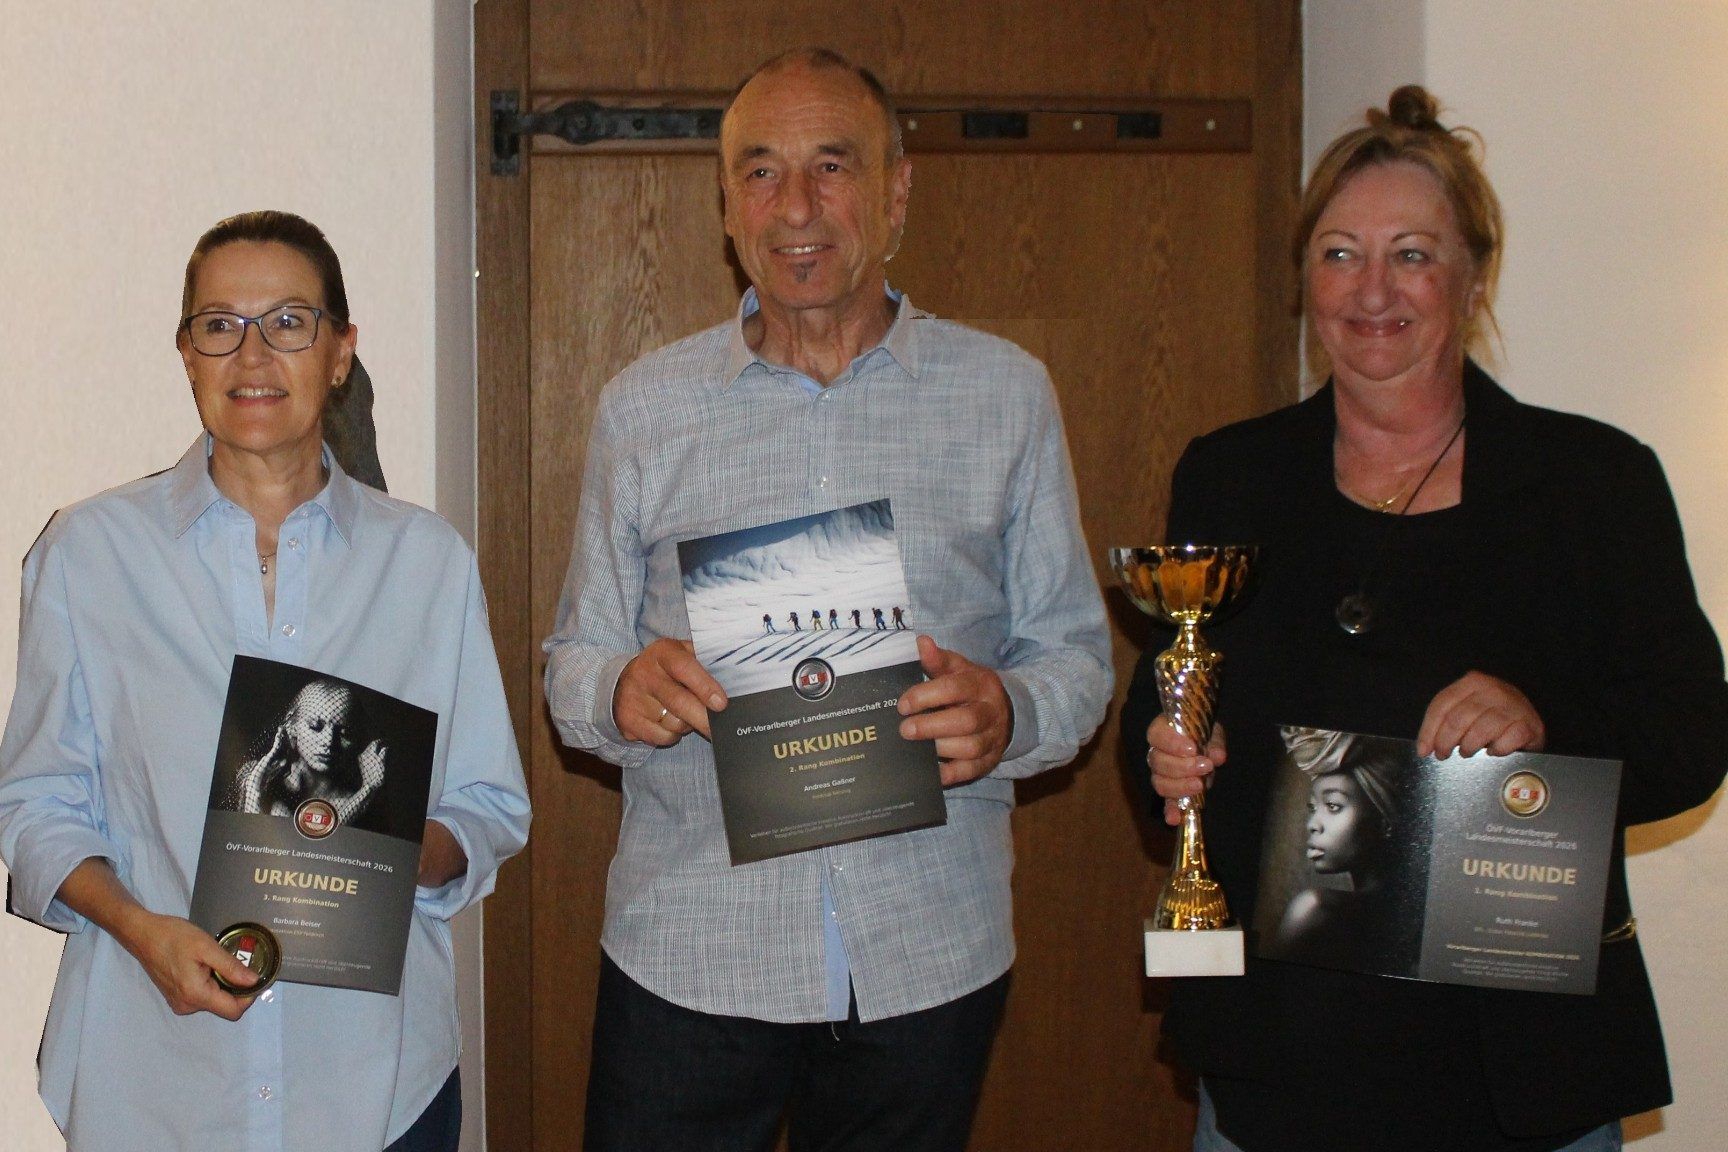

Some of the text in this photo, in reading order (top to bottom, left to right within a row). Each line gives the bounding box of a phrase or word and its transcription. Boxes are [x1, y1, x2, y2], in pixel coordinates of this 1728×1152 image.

[736, 698, 898, 736] ÖVF-Vorarlberger Landesmeisterschaft 202
[773, 725, 878, 760] URKUNDE
[798, 762, 818, 772] Rang
[818, 753, 866, 767] Kombination
[803, 782, 831, 792] Andreas
[226, 842, 394, 873] ÖVF-Vorarlberger Landesmeisterschaft 2026
[254, 868, 359, 895] URKUNDE
[1462, 858, 1578, 885] URKUNDE
[272, 895, 291, 904] Rang
[292, 896, 340, 908] Kombination
[273, 917, 299, 926] Barbara
